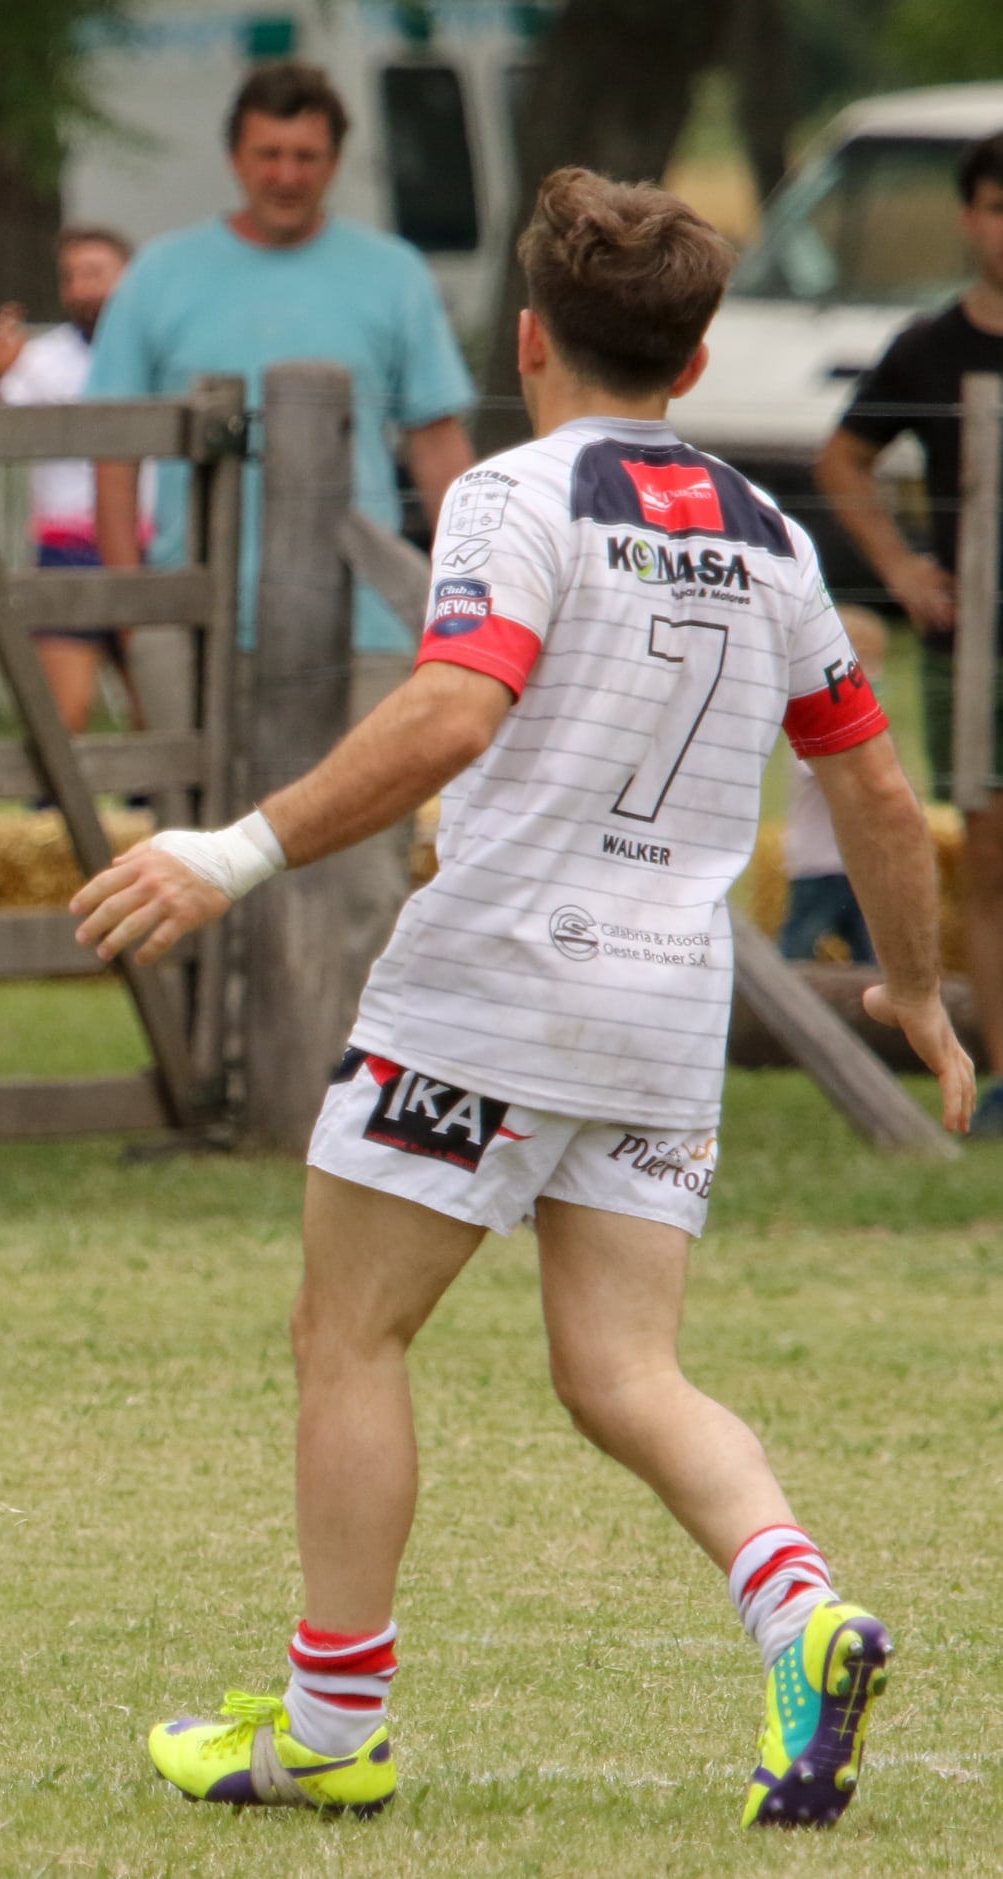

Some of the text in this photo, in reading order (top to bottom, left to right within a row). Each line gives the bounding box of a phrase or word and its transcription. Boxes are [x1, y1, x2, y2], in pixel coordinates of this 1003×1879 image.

[610, 613, 729, 823] 7
[602, 834, 671, 867] WALKER
[601, 923, 652, 944] Calabria
[654, 934, 664, 946] &
[603, 943, 642, 960] Oeste
[643, 948, 685, 965] Broker
